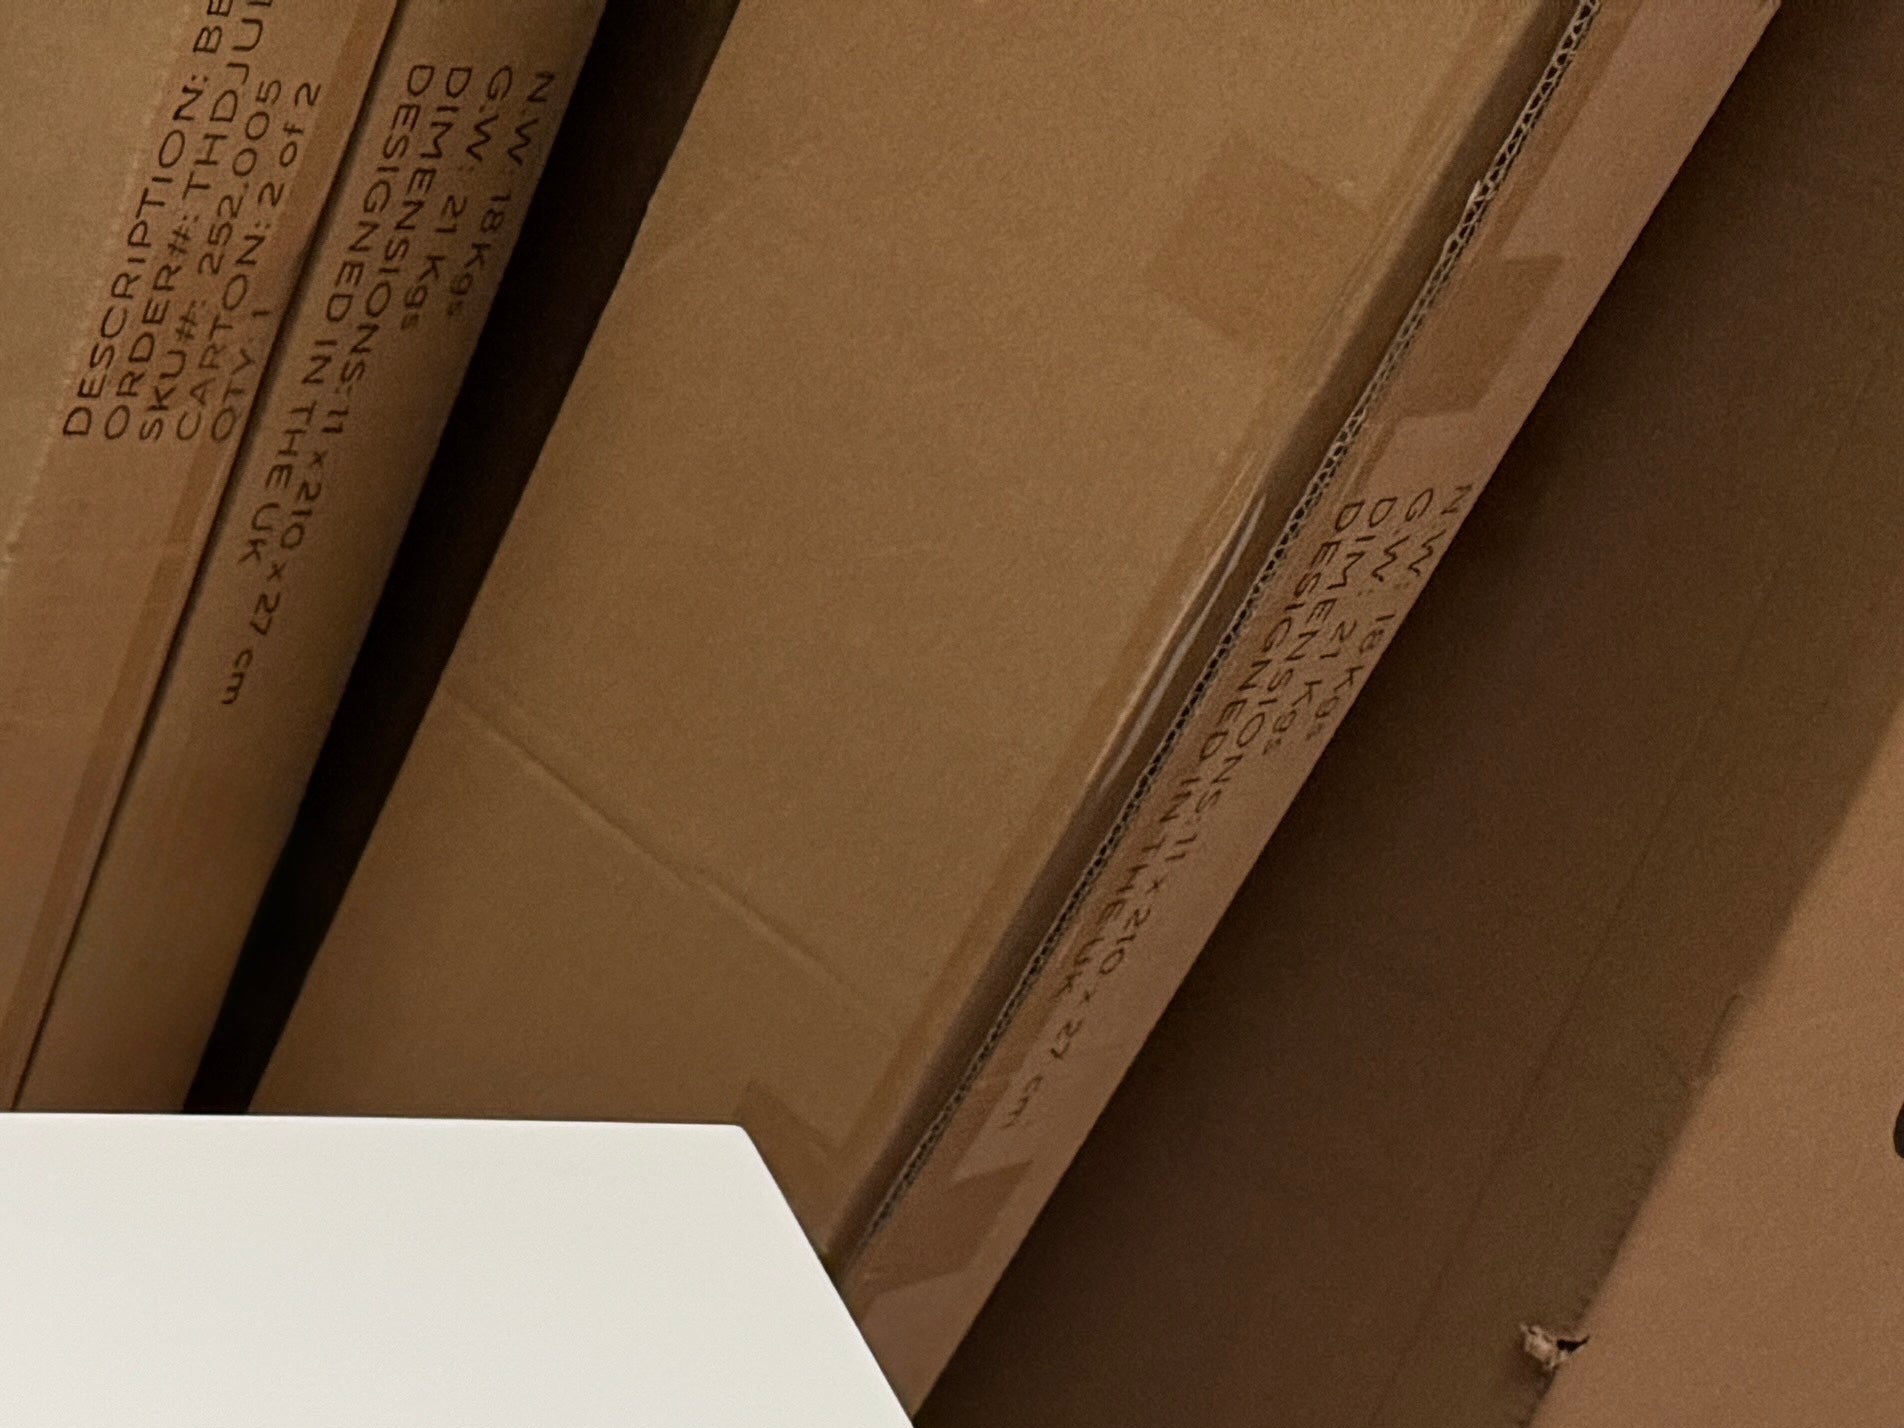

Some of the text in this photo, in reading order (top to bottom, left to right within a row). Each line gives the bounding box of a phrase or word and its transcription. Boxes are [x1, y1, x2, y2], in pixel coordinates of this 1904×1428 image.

[335, 66, 473, 395] DIMENSIONS:
[435, 195, 468, 234] 21
[480, 193, 511, 233] 18
[62, 74, 208, 438] DESCRIPTION:
[139, 79, 283, 441] SKU#: 252.005
[176, 81, 322, 441] CARTON: 2 of 2
[104, 214, 200, 441] ORDER#:
[238, 65, 435, 565] DESIGNED IN THE UK
[401, 255, 446, 331] Kgs
[322, 409, 349, 434] 11
[279, 482, 323, 550] 210
[249, 592, 281, 635] 27
[1320, 620, 1357, 660] 21
[221, 650, 253, 705] cm
[1185, 496, 1399, 828] DIMENSIONS:
[1053, 500, 1365, 1001] DESIGNED IN THE UK
[1098, 907, 1152, 976] 210
[1049, 1018, 1084, 1061] 27
